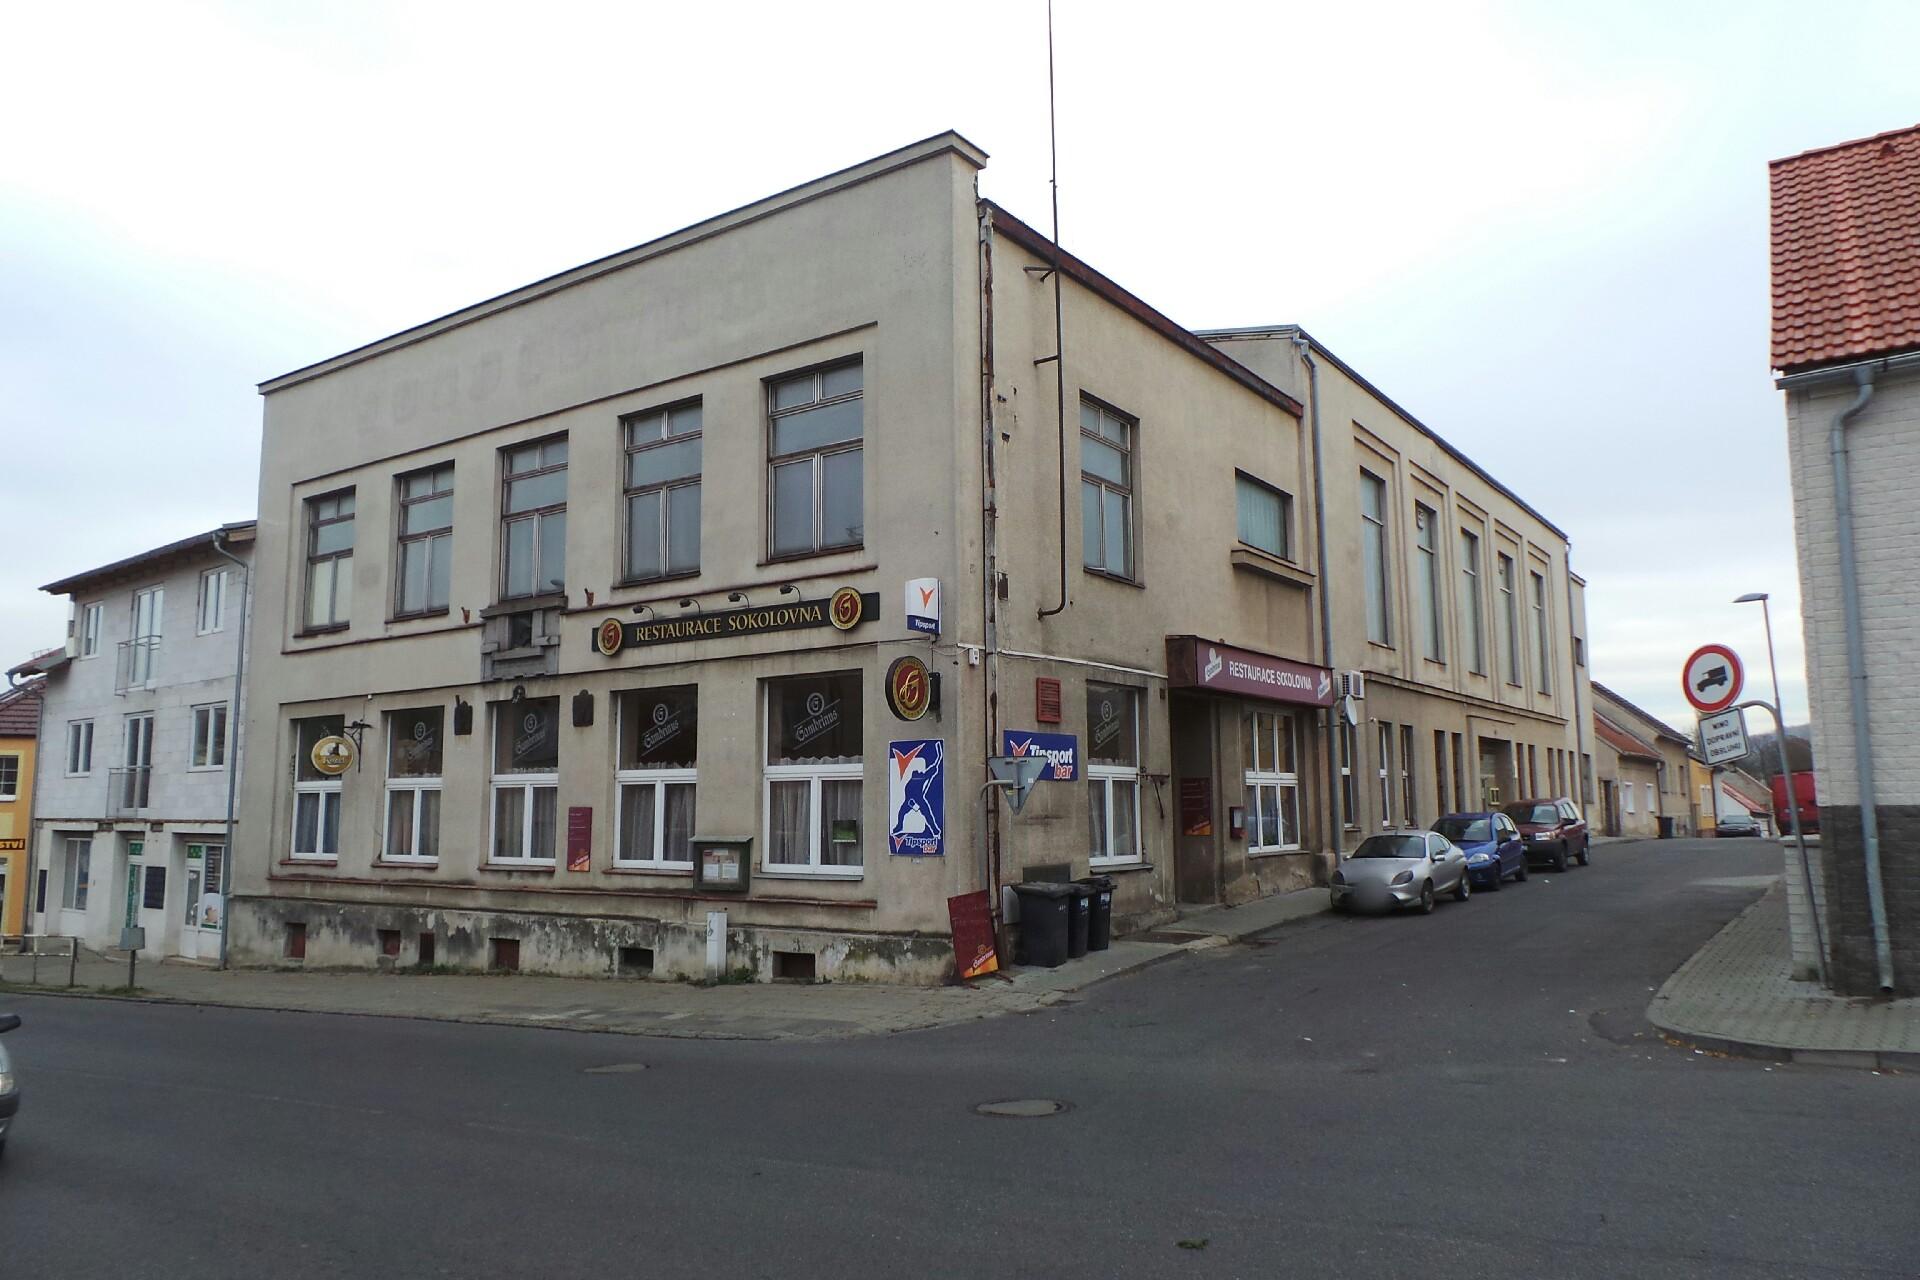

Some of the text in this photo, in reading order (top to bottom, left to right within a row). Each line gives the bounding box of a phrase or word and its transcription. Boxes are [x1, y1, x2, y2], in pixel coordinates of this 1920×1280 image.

[636, 605, 822, 642] RESTAURACE SOKOLOVNA
[914, 619, 936, 630] Tipsport
[1229, 660, 1276, 684] RESTAURACE
[1277, 671, 1312, 690] SOKOLOVNA
[644, 719, 679, 748] Gambrinus
[796, 710, 838, 741] Gambrinus
[1053, 763, 1073, 779] bar
[905, 836, 937, 849] Tipsport
